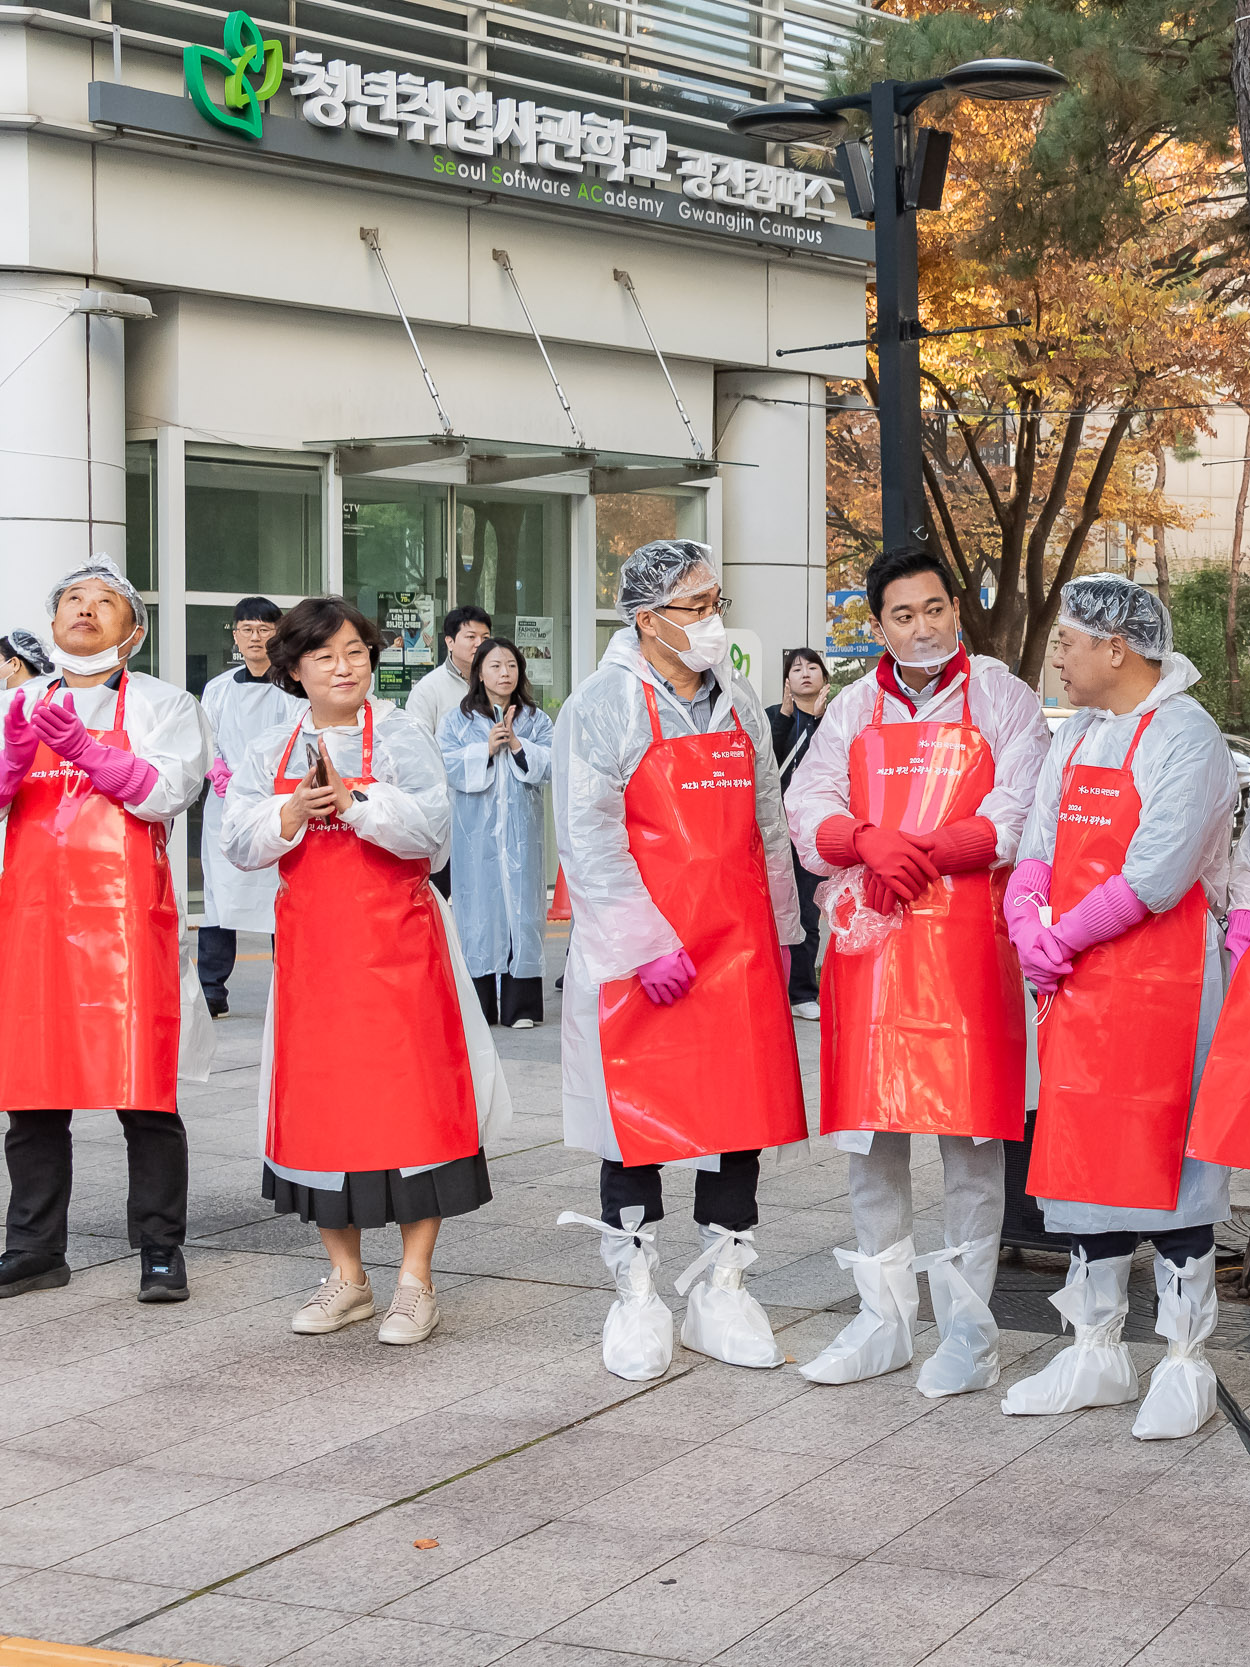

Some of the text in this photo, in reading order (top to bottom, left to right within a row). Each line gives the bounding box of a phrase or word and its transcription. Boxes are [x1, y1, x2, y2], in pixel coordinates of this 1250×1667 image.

[290, 50, 837, 218] 청년취업사관학교 광진캠퍼스
[433, 154, 824, 245] Seoul Software ACademy Gwangjin Campus
